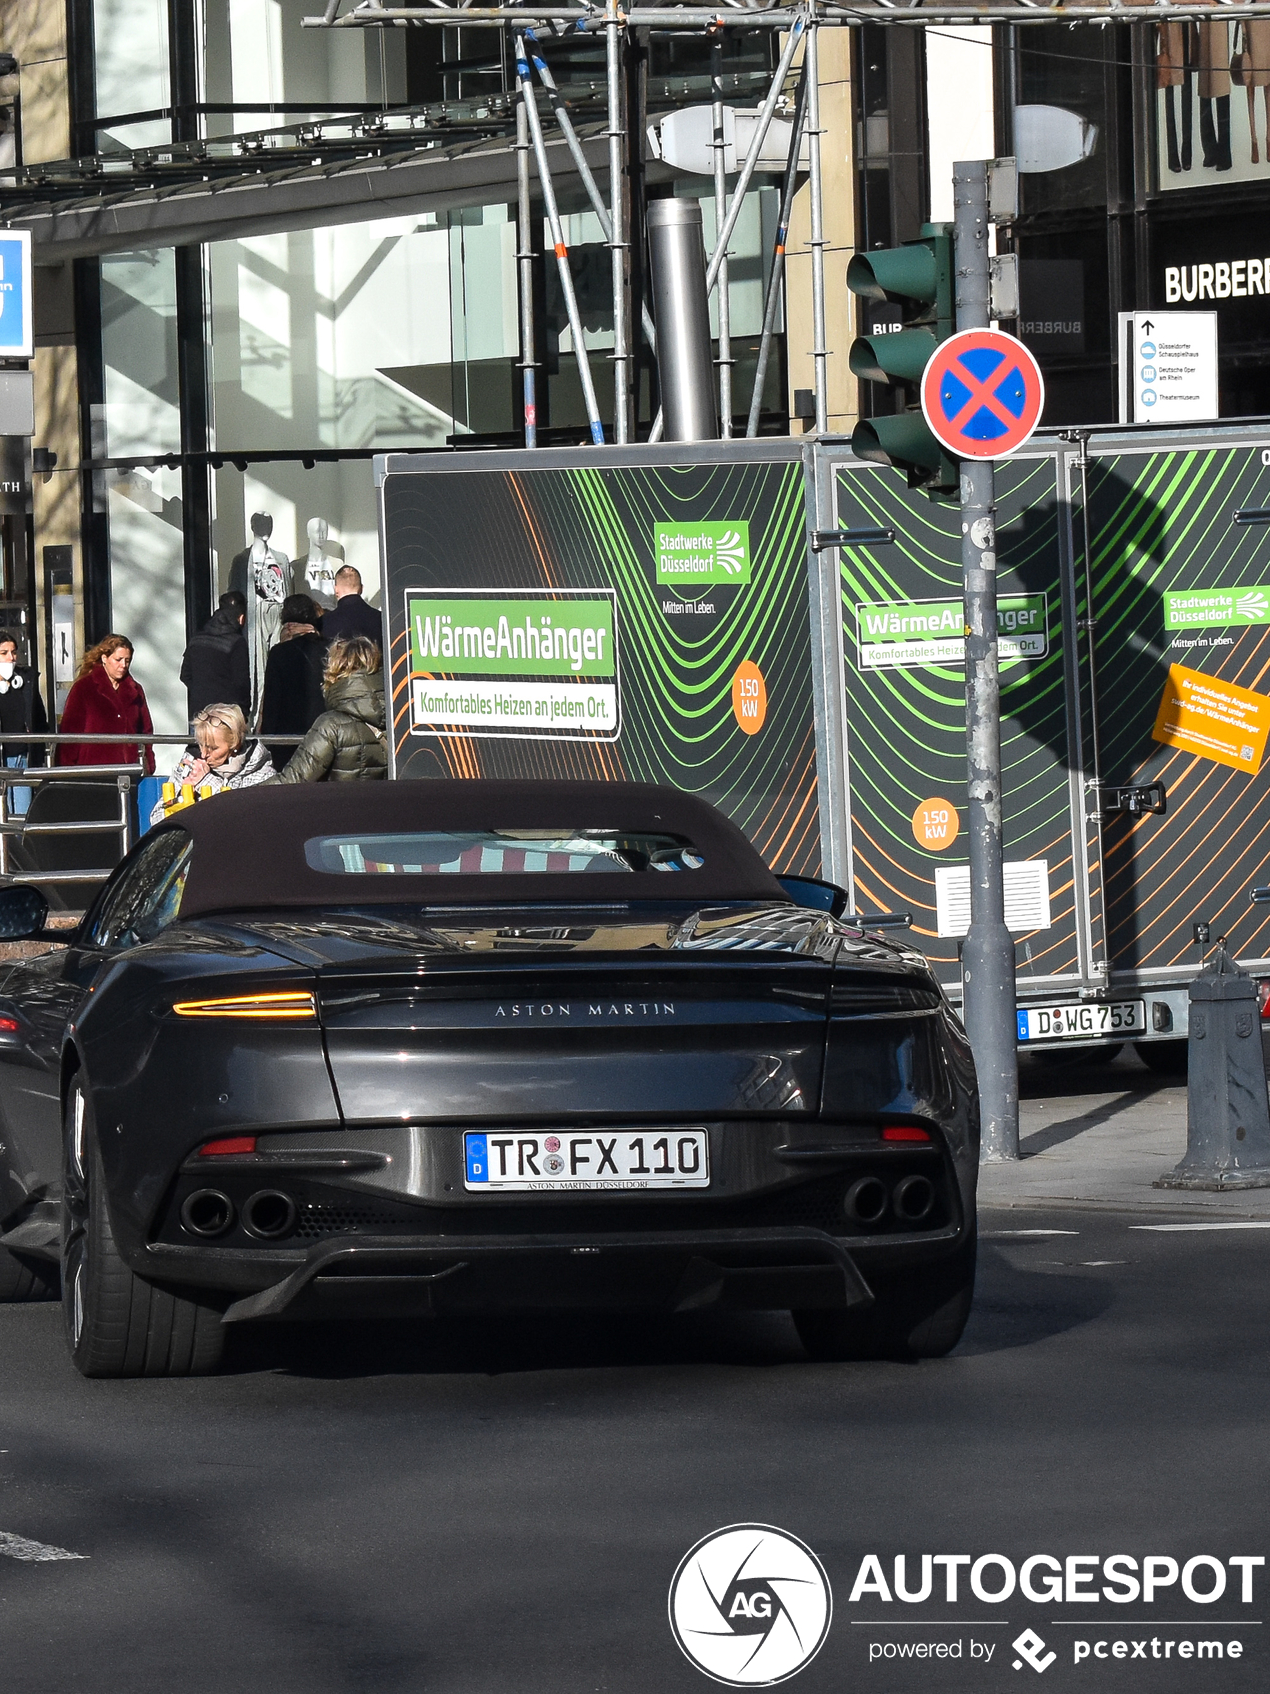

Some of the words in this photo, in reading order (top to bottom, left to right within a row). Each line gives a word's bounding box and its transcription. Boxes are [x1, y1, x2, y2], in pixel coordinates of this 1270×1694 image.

[659, 533, 713, 550] Stadtwerke
[660, 555, 713, 573] Düsseldorf
[662, 601, 684, 614] Mitten
[685, 601, 693, 614] im
[694, 601, 716, 614] Leben.
[1170, 595, 1233, 609] Stadtwerke
[865, 609, 1037, 635] WärmeAnnger
[1170, 608, 1233, 623] Düsseldorf
[416, 614, 606, 671] WärmeAnhänger
[868, 646, 935, 660] Komfortables
[937, 645, 965, 656] Heize
[998, 642, 1018, 652] dem
[1020, 640, 1039, 651] Ort.
[1172, 639, 1197, 648] Mitten
[1198, 639, 1208, 647] im
[1209, 637, 1234, 646] Leben.
[739, 678, 759, 697] 150
[420, 691, 492, 715] Komfortables
[494, 694, 532, 716] Heizen
[534, 699, 548, 716] an
[550, 696, 585, 721] jedem
[587, 696, 609, 718] Ort.
[1190, 694, 1217, 708] erhalten
[1217, 702, 1228, 712] Sie
[1228, 707, 1246, 718] unter
[1192, 683, 1231, 703] individuelles
[1231, 697, 1259, 713] Angebot
[741, 699, 758, 718] kW
[923, 810, 948, 825] 150
[925, 825, 947, 839] kW
[495, 1004, 570, 1017] ASTON
[589, 1003, 676, 1015] MARTIN
[1038, 1012, 1051, 1034] D
[1066, 1008, 1093, 1032] WG
[1097, 1004, 1136, 1029] 753
[1020, 1027, 1027, 1035] D
[491, 1139, 541, 1176] TR
[570, 1138, 619, 1175] FX
[629, 1137, 700, 1174] 110
[473, 1163, 483, 1174] D
[560, 1182, 591, 1190] MARTIN
